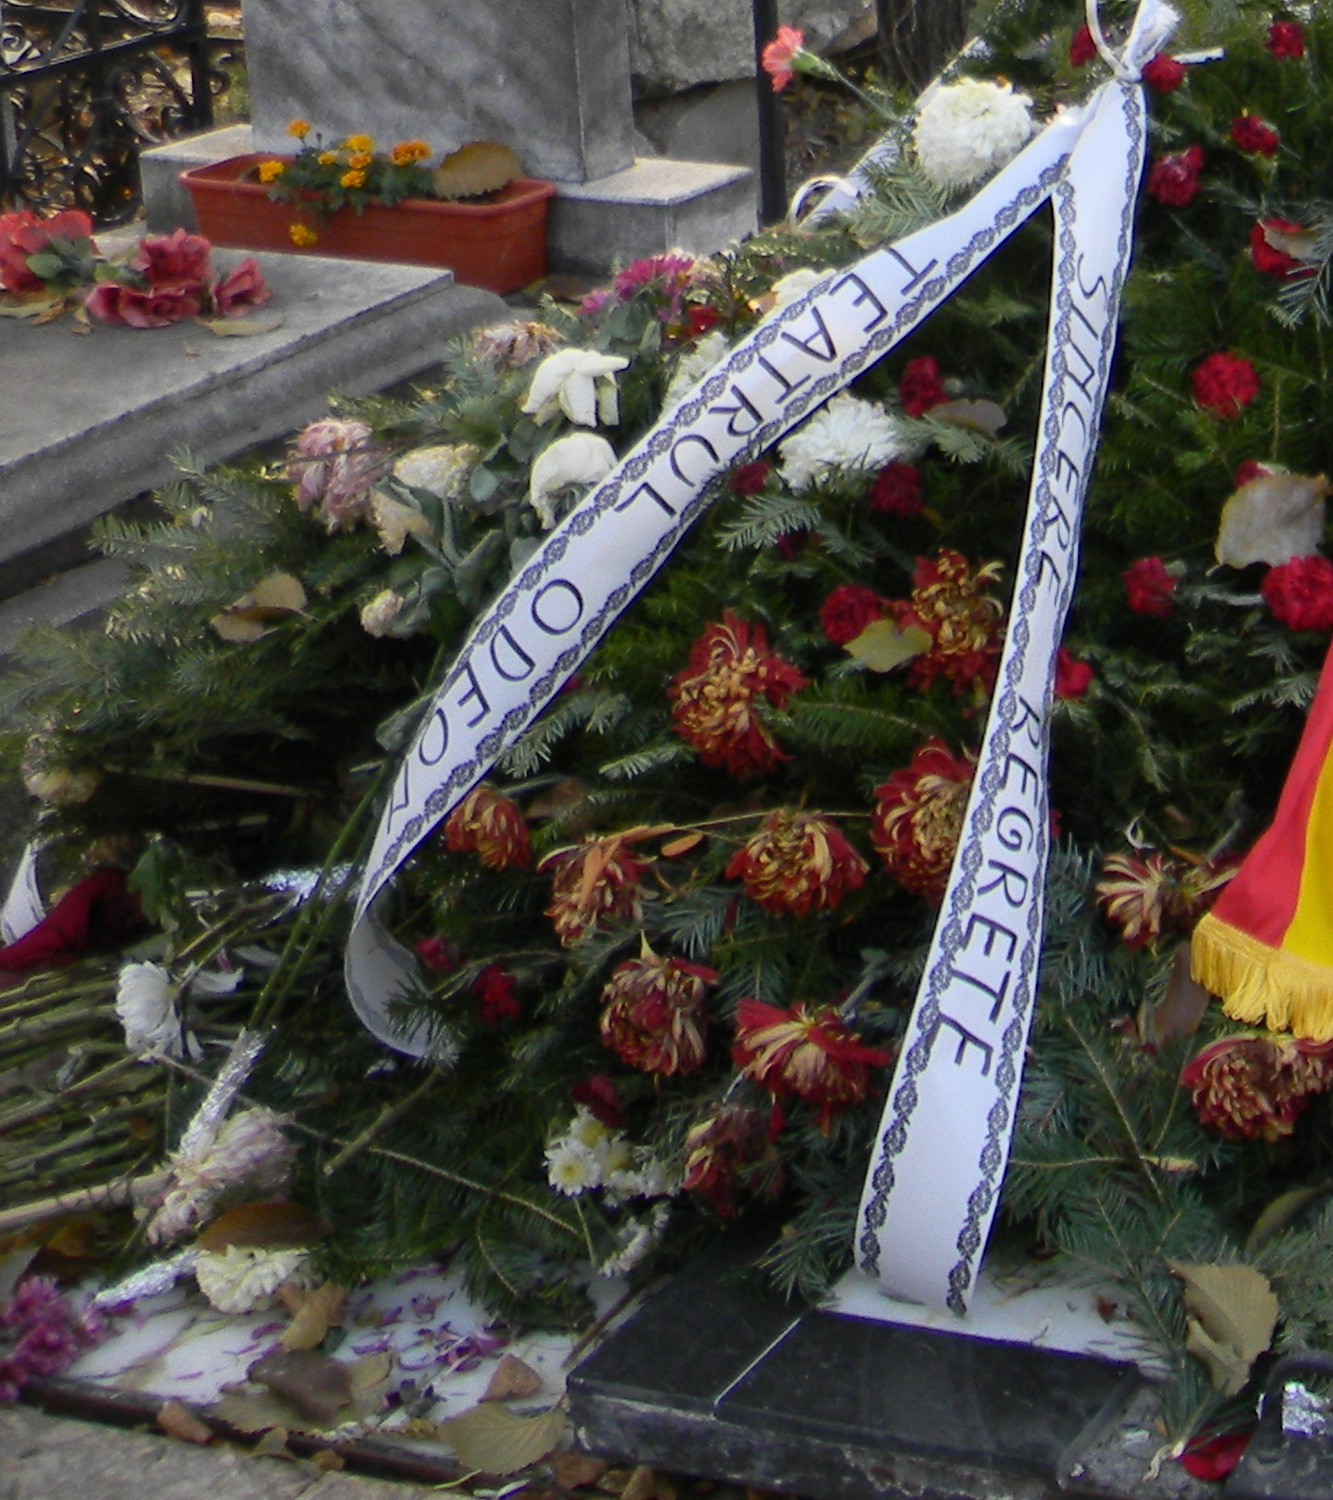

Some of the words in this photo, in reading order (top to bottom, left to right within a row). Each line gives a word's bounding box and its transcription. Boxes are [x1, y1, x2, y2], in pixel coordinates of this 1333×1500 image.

[614, 243, 939, 519] TEATRUL
[1038, 251, 1107, 608] SINCERE
[931, 696, 1041, 1080] REGRETE
